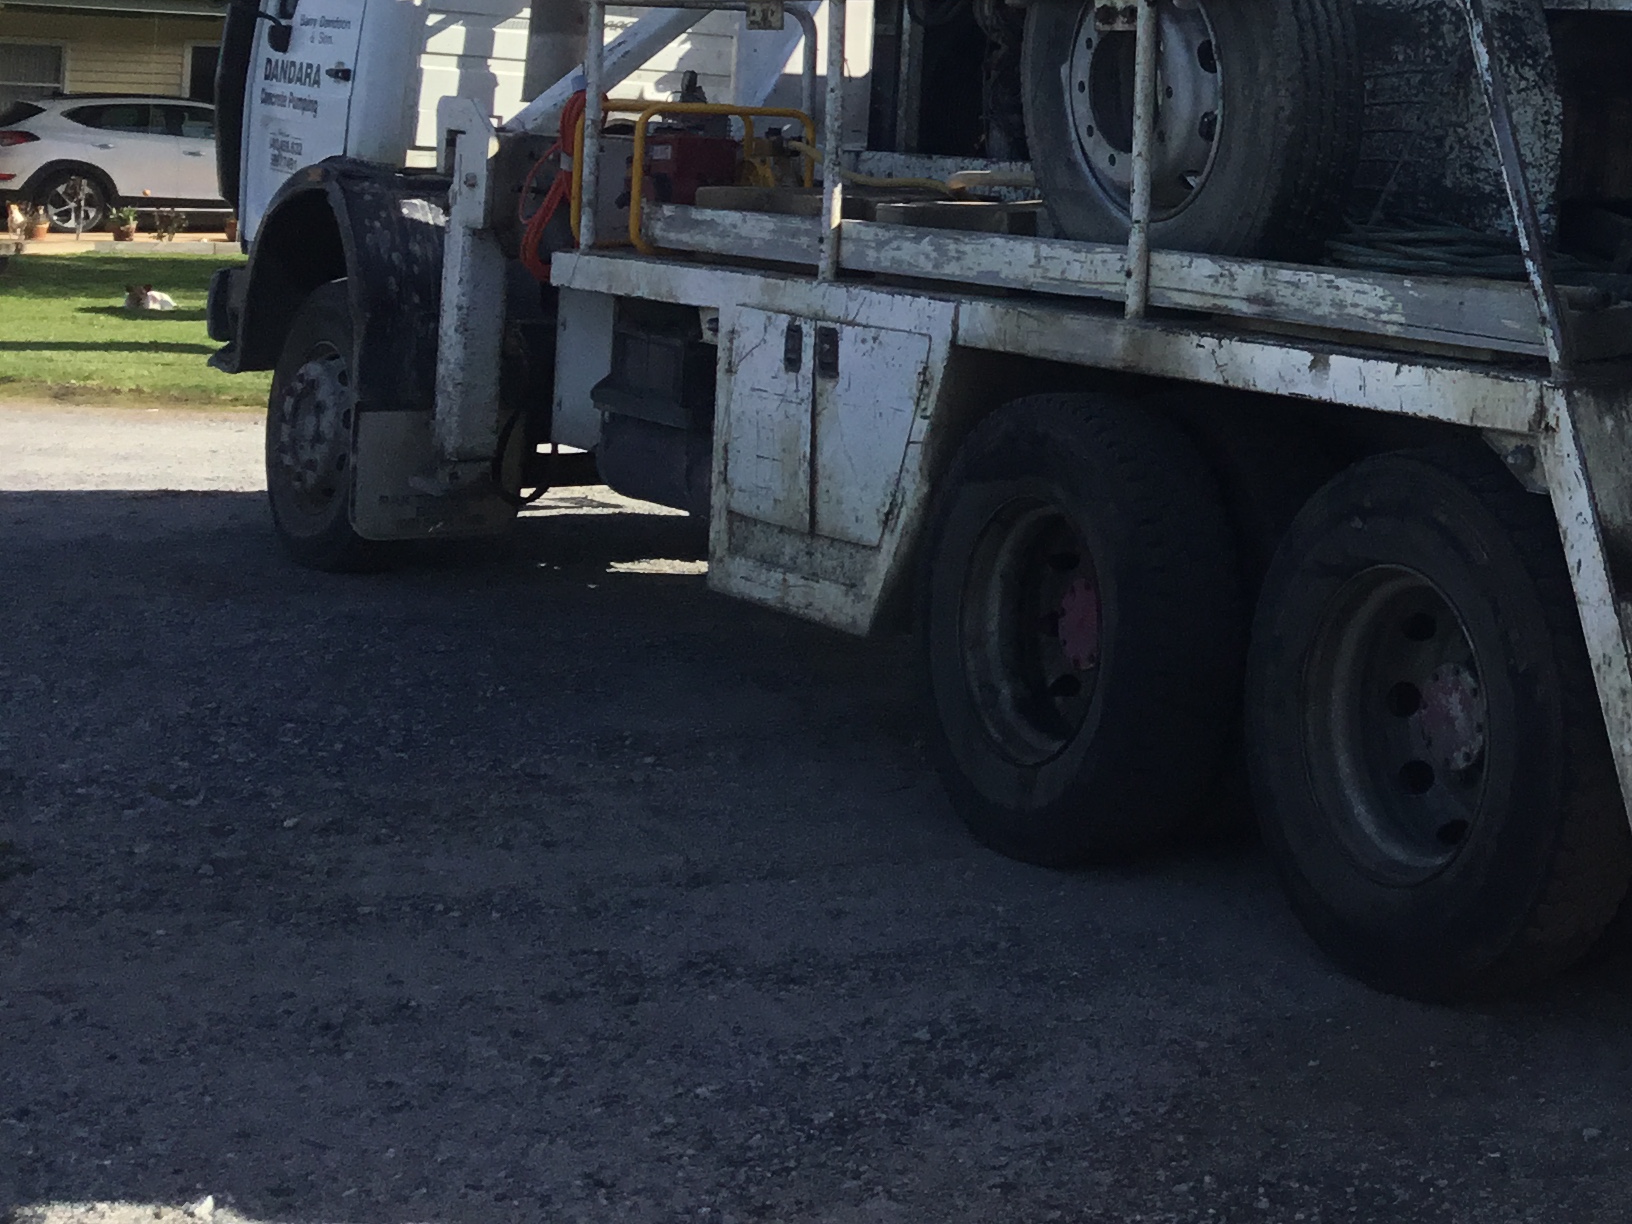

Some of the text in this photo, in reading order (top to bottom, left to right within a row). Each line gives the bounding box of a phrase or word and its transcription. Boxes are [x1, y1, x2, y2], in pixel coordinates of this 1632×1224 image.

[264, 57, 321, 88] DANDARA
[260, 88, 318, 117] Concrete Pumping
